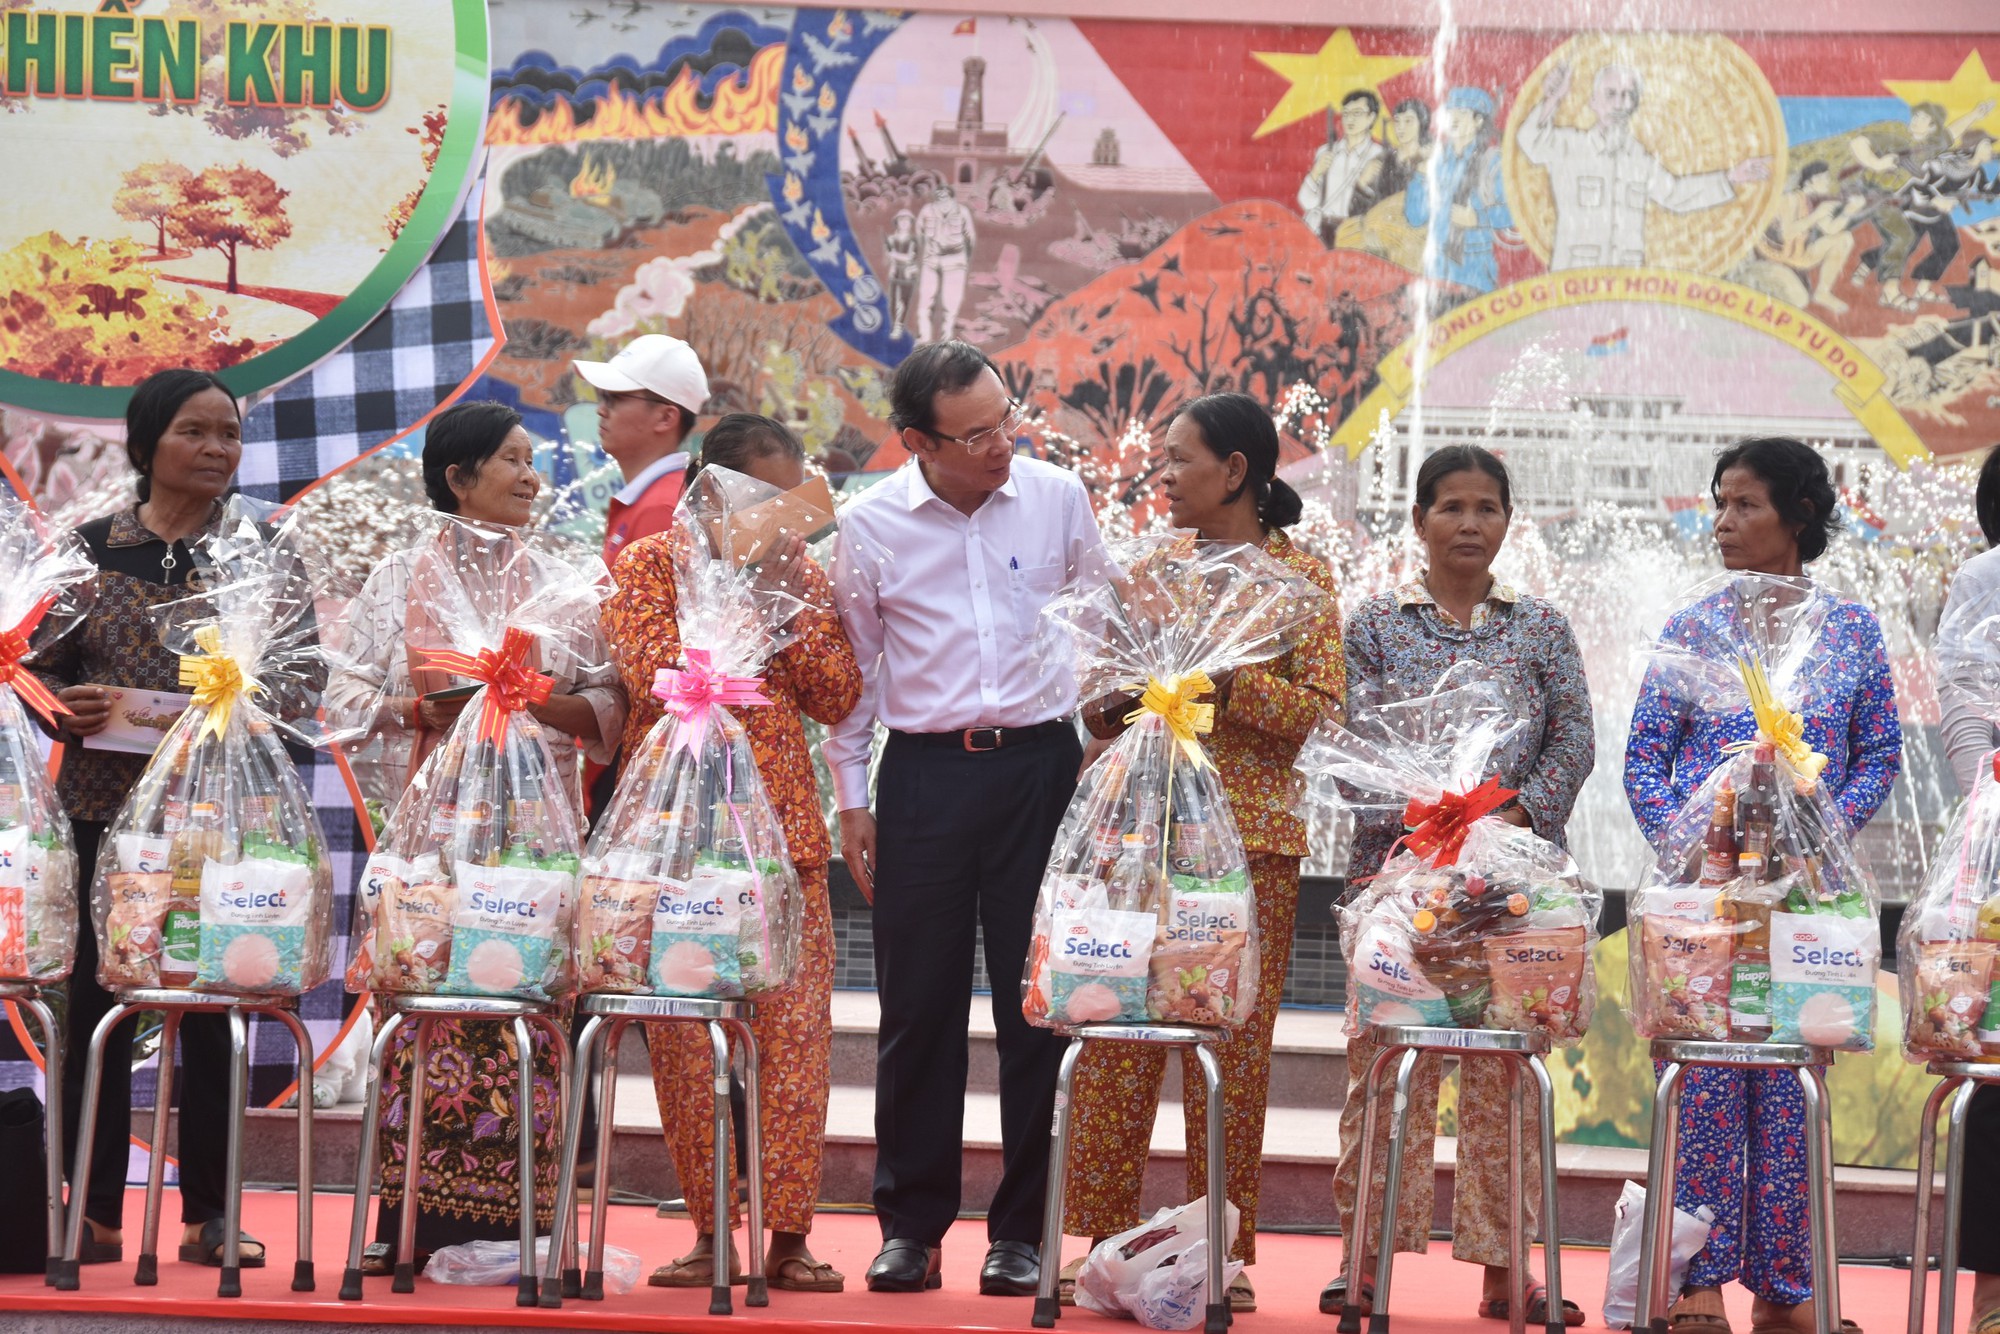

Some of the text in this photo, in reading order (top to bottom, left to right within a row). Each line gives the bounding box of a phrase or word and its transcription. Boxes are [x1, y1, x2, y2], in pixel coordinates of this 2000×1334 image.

[224, 20, 392, 112] KHU
[1826, 344, 1859, 379] DO
[218, 887, 287, 909] Select
[662, 883, 686, 895] COOP
[470, 891, 538, 918] Select
[656, 894, 725, 916] Select
[1674, 901, 1699, 910] COOP
[1068, 926, 1089, 934] COOP
[1176, 910, 1238, 929] Select
[1165, 926, 1224, 943] Select
[1662, 933, 1708, 954] Selet
[1064, 937, 1132, 958] Select
[1505, 946, 1565, 963] Select
[1792, 945, 1864, 968] Select
